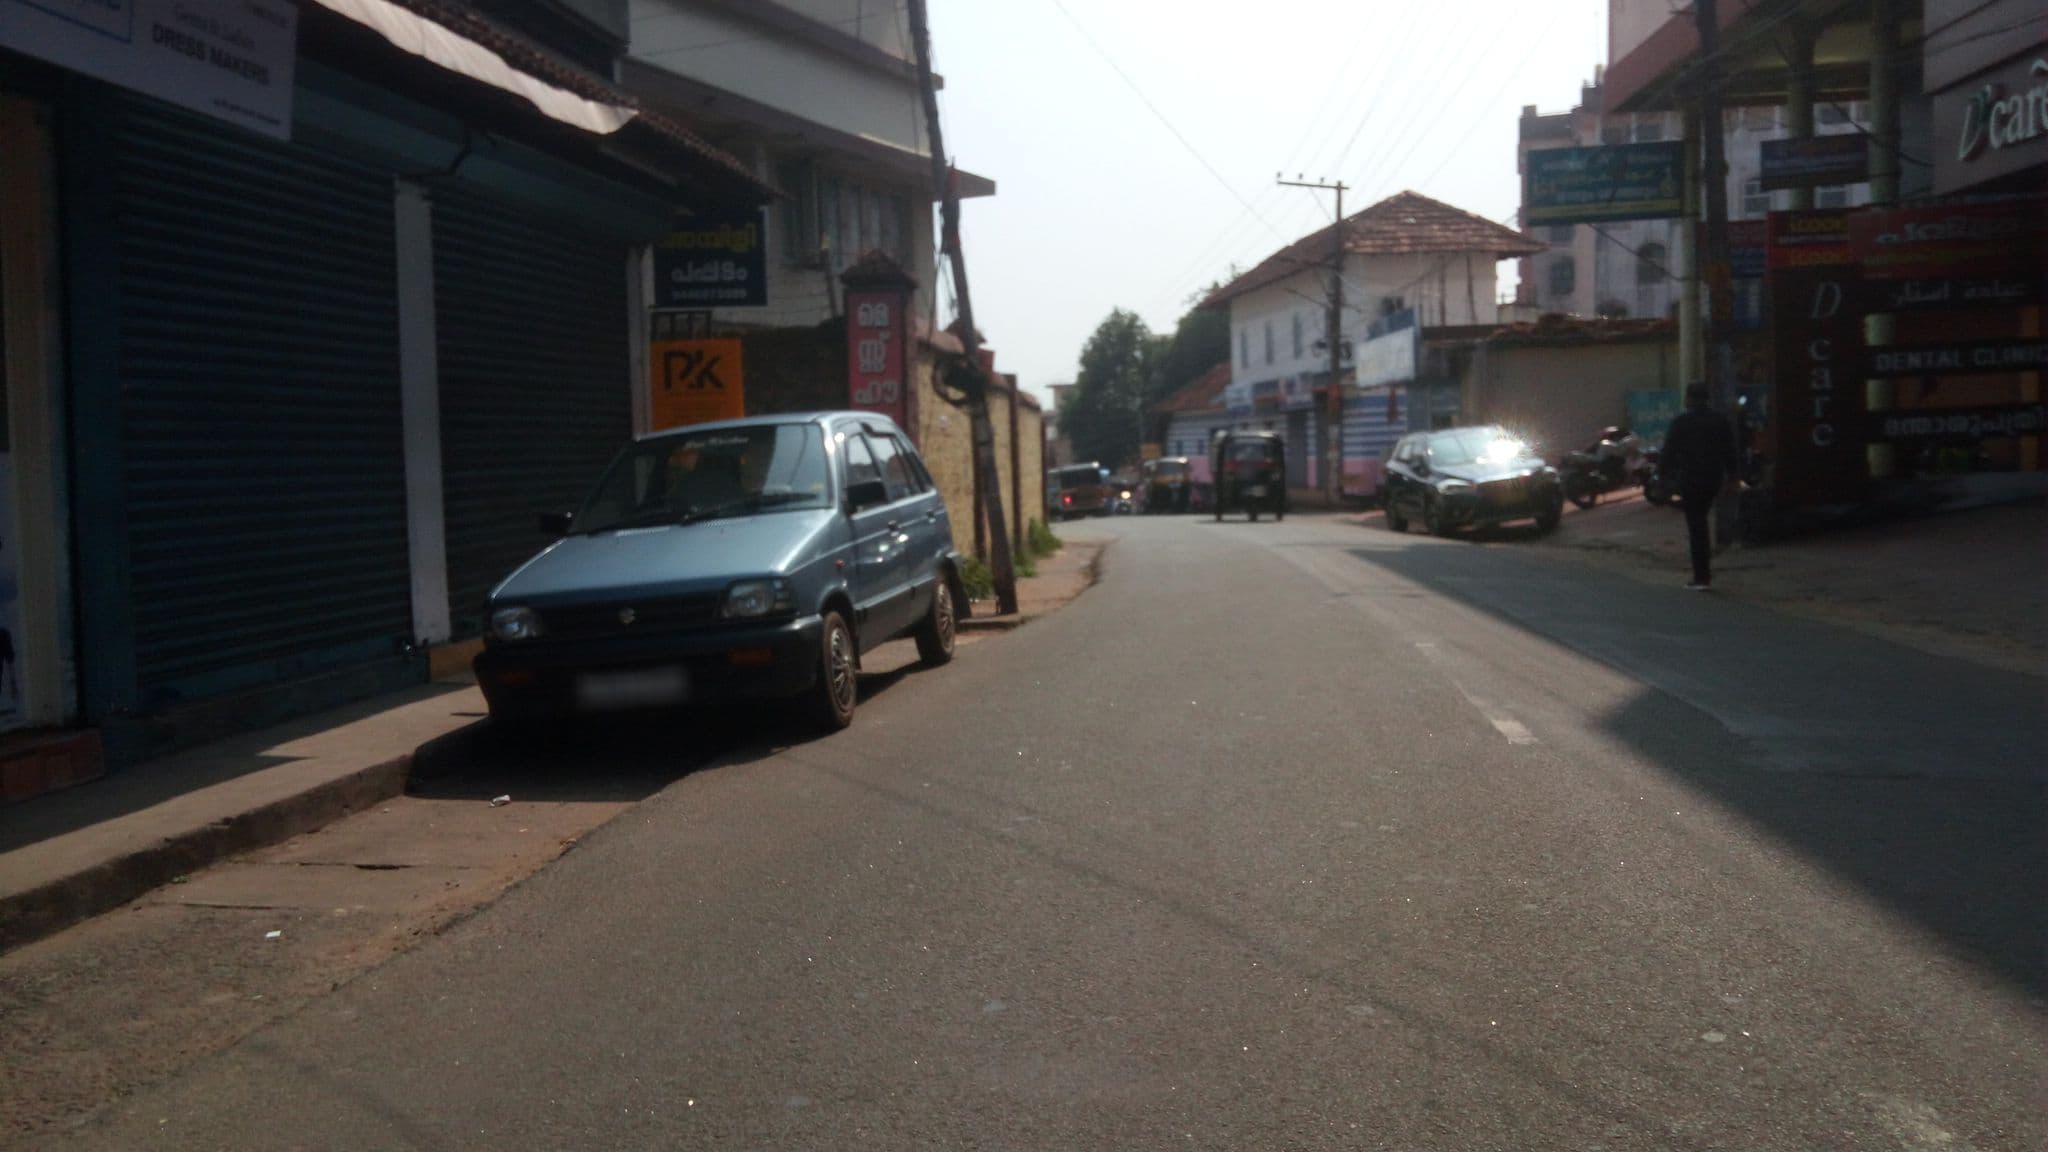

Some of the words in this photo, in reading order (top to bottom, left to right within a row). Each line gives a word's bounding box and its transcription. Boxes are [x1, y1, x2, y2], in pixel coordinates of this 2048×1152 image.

[152, 22, 206, 61] DRESS
[209, 46, 270, 85] MAKERS
[1875, 350, 1962, 372] DENTAL
[1974, 343, 2048, 366] CLINIC
